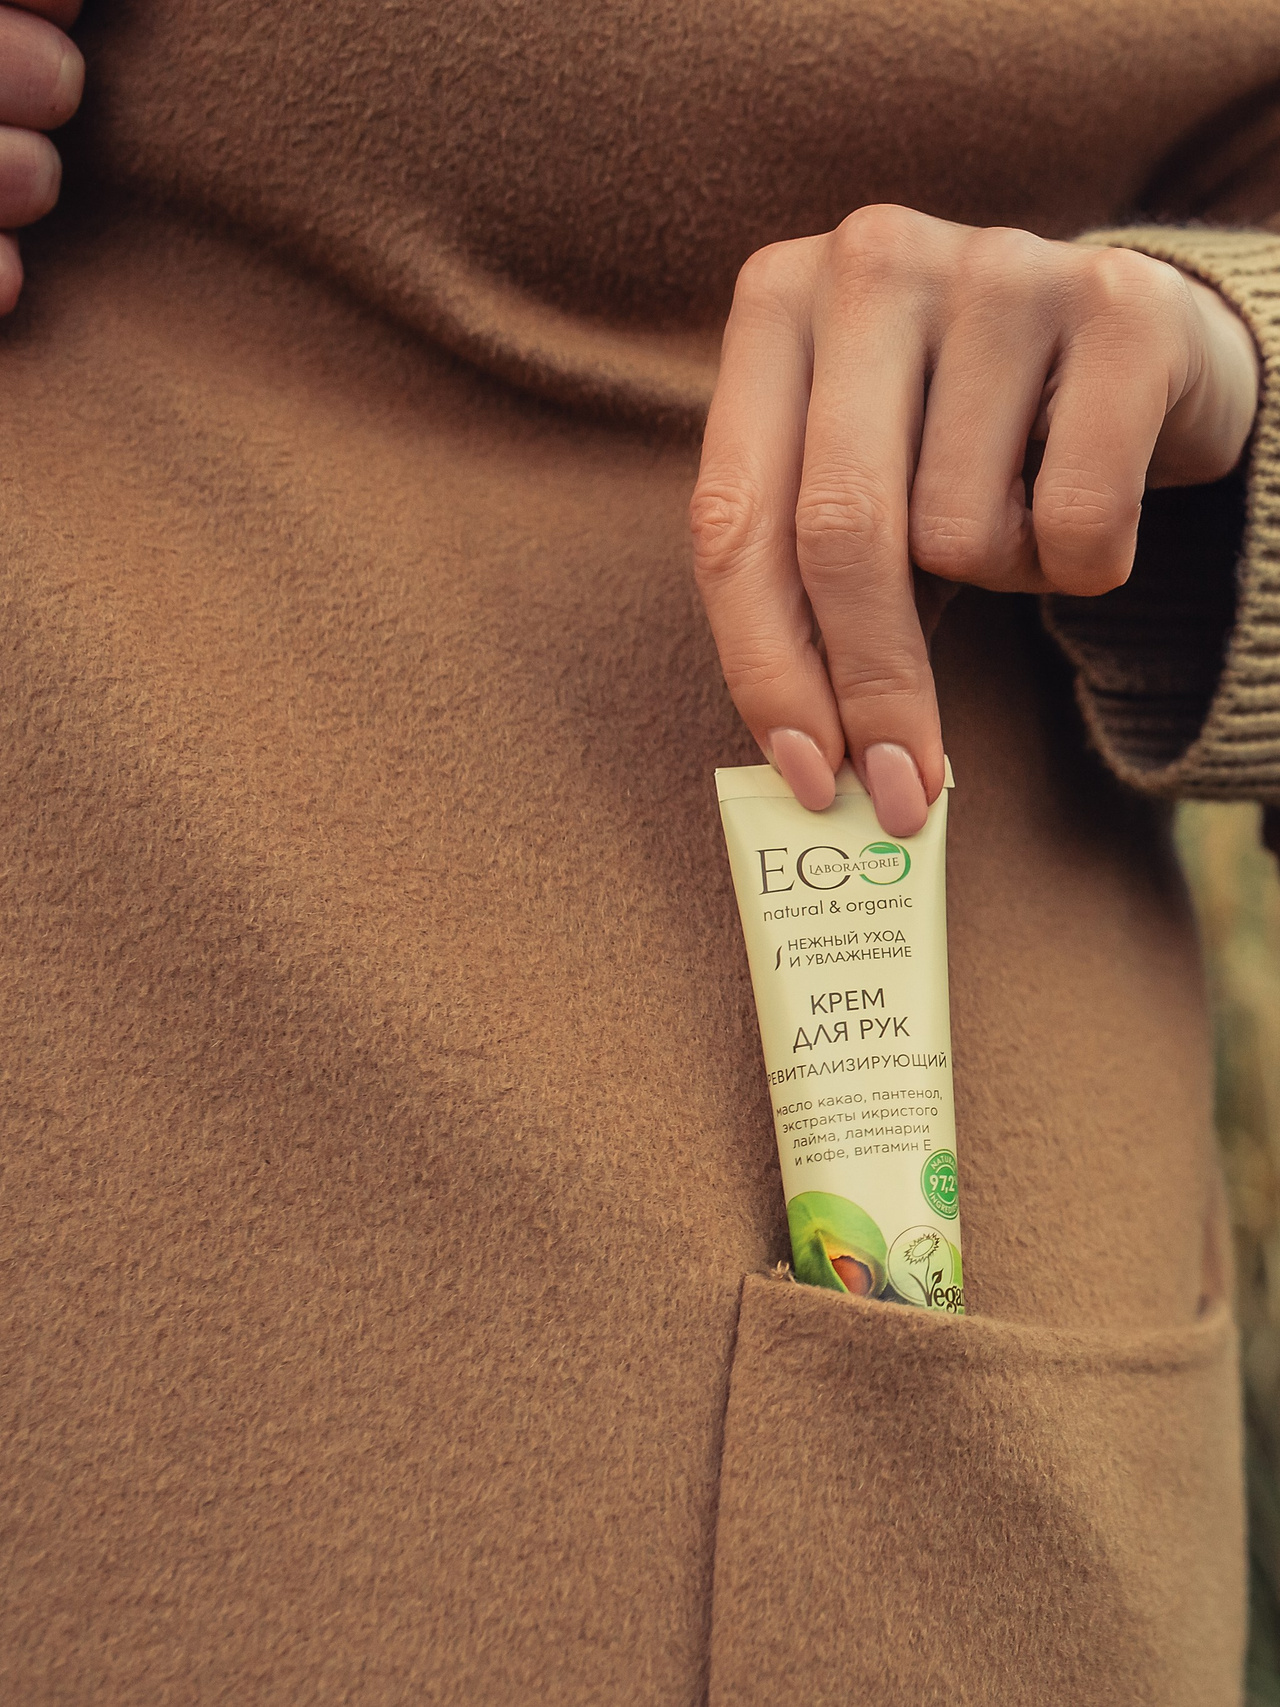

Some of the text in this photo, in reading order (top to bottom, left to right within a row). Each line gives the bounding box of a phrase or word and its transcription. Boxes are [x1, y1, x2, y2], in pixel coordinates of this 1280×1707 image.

[809, 857, 899, 875] LABORATORIE
[763, 895, 913, 921] natural & organic
[787, 930, 906, 951] НЕЖНЫЙ УХОД
[789, 946, 912, 968] И УВЛАЖНЕНИЕ
[810, 988, 885, 1015] КРЕМ
[792, 1016, 910, 1054] ДЛЯ РУК
[776, 1088, 943, 1117] масло какао, пантенол,
[782, 1106, 938, 1134] экстракты икристого
[793, 1124, 930, 1149] лайма, ламинарии
[795, 1155, 803, 1167] и
[807, 1147, 849, 1163] кофе,
[854, 1142, 919, 1156] витамин
